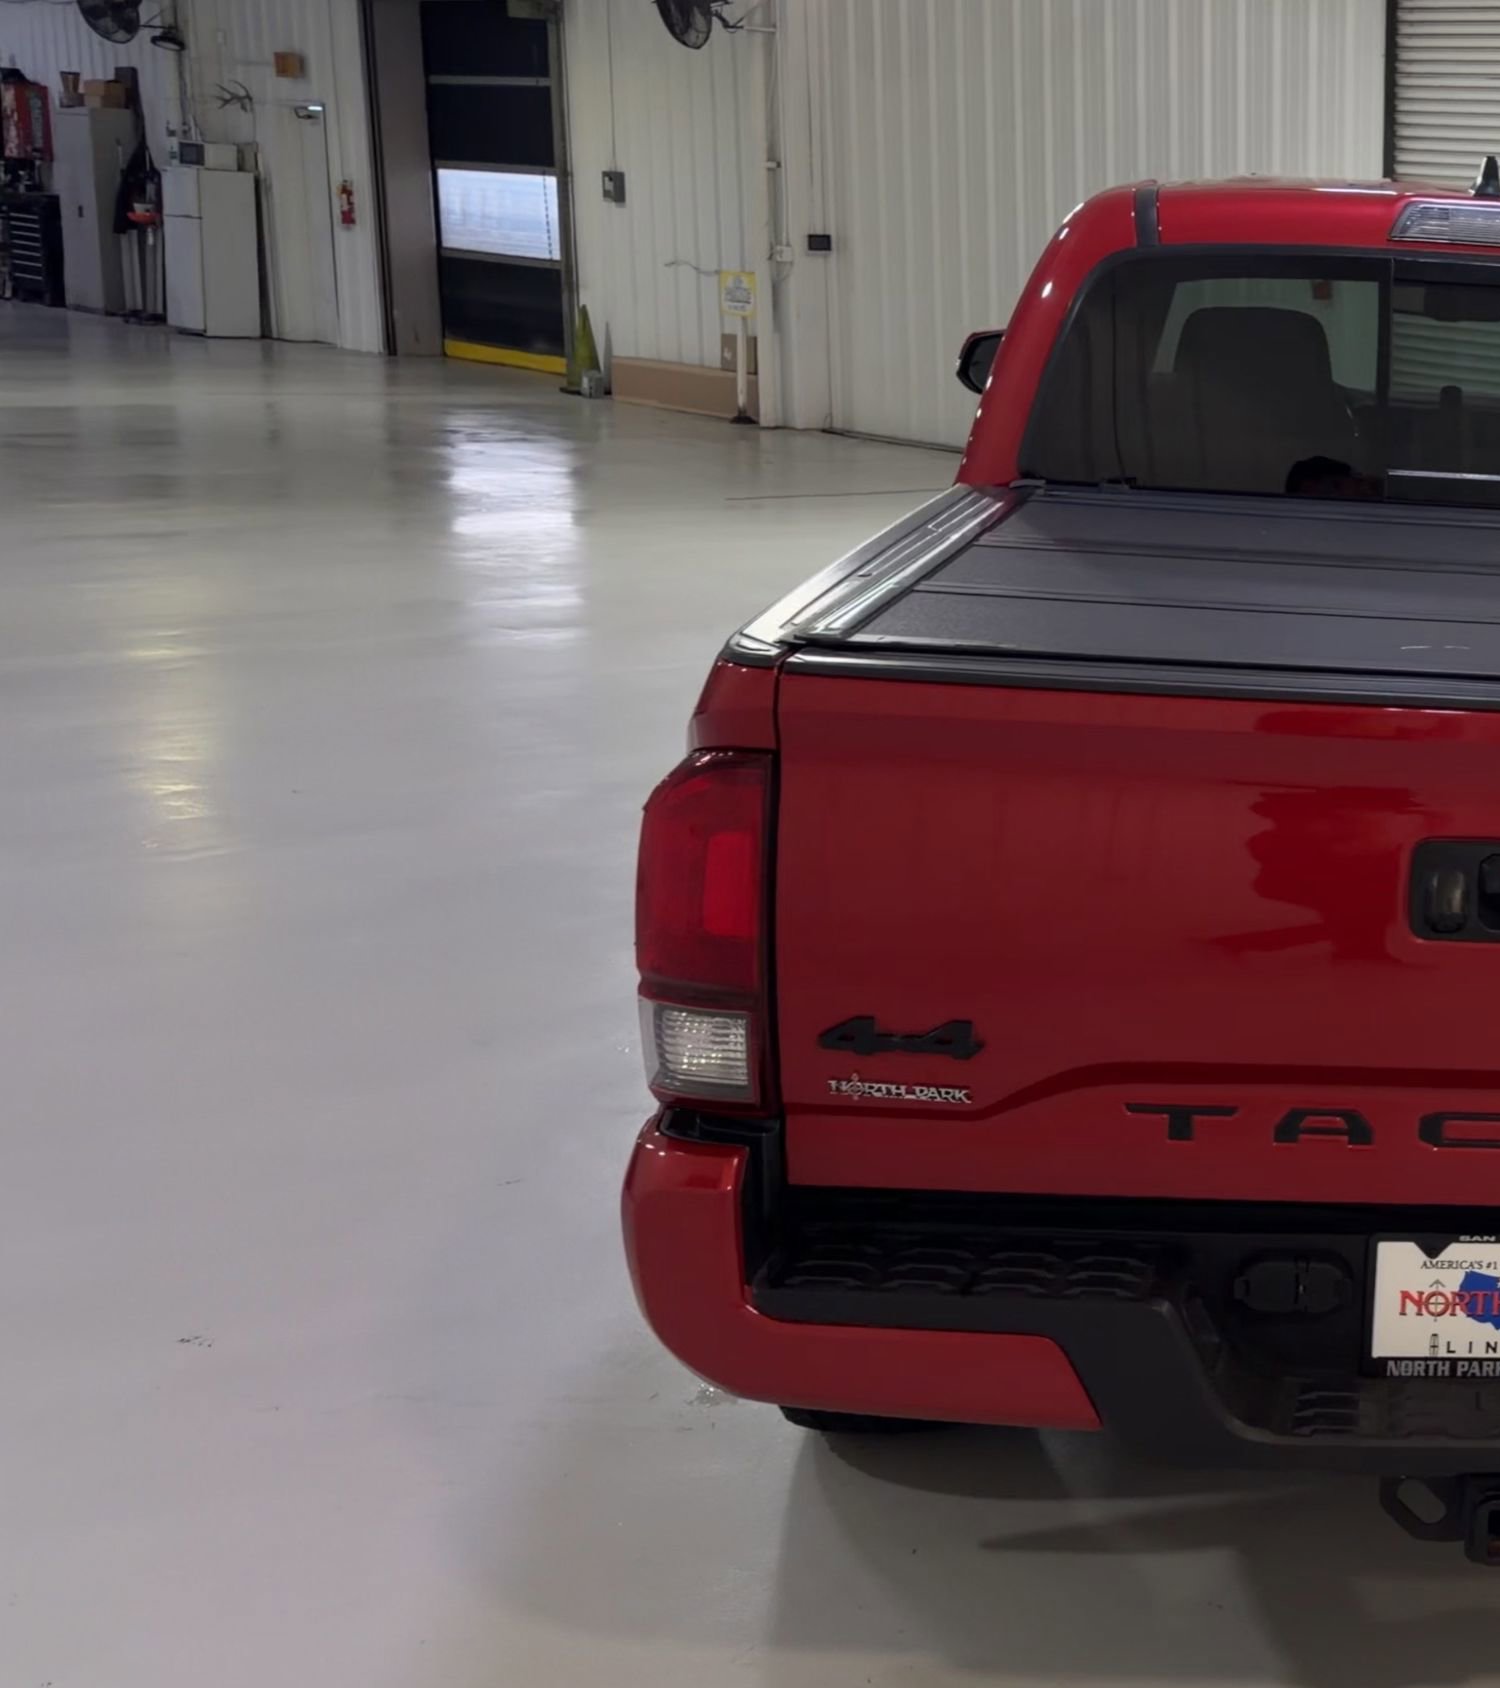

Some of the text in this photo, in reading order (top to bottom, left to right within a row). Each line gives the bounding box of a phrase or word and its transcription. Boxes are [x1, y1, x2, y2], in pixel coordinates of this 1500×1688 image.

[828, 1080, 972, 1104] NORTH PARK
[1420, 1260, 1484, 1270] AMERICA'S
[1486, 1261, 1498, 1270] #1
[1386, 1360, 1450, 1377] NORTH
